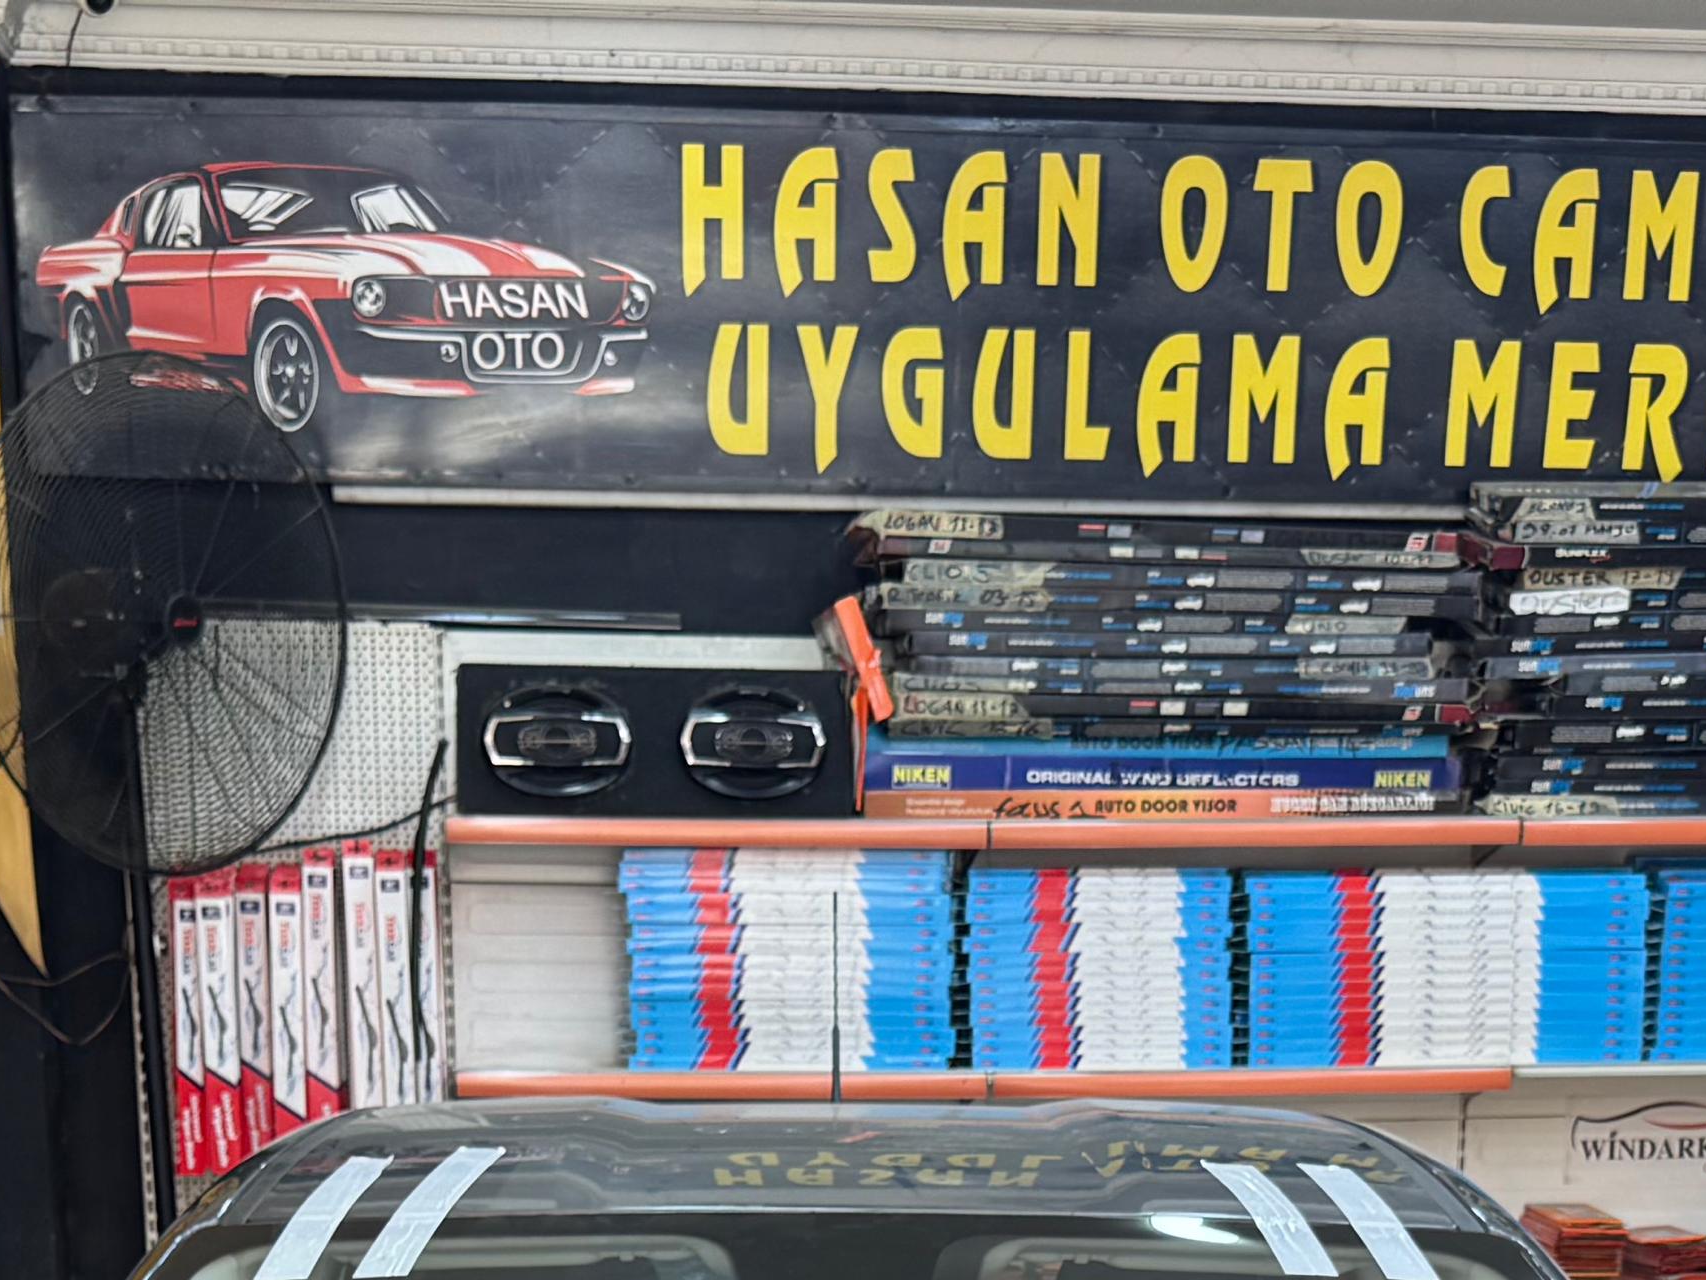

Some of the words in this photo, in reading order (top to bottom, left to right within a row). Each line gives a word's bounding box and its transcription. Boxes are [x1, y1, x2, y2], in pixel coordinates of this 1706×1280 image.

[681, 143, 1101, 301] HASAN
[1160, 155, 1403, 297] OTO
[1459, 165, 1699, 315] CAM
[440, 281, 590, 319] HASAN
[472, 331, 565, 370] OTO
[707, 324, 1390, 482] UYGULAMA
[893, 765, 950, 785] NIKEN
[1026, 769, 1113, 786] ORIGINAL
[1374, 770, 1432, 788] NIKEN
[1095, 800, 1136, 814] AUTO
[1140, 800, 1189, 814] DOOR
[1192, 799, 1238, 814] VISOR
